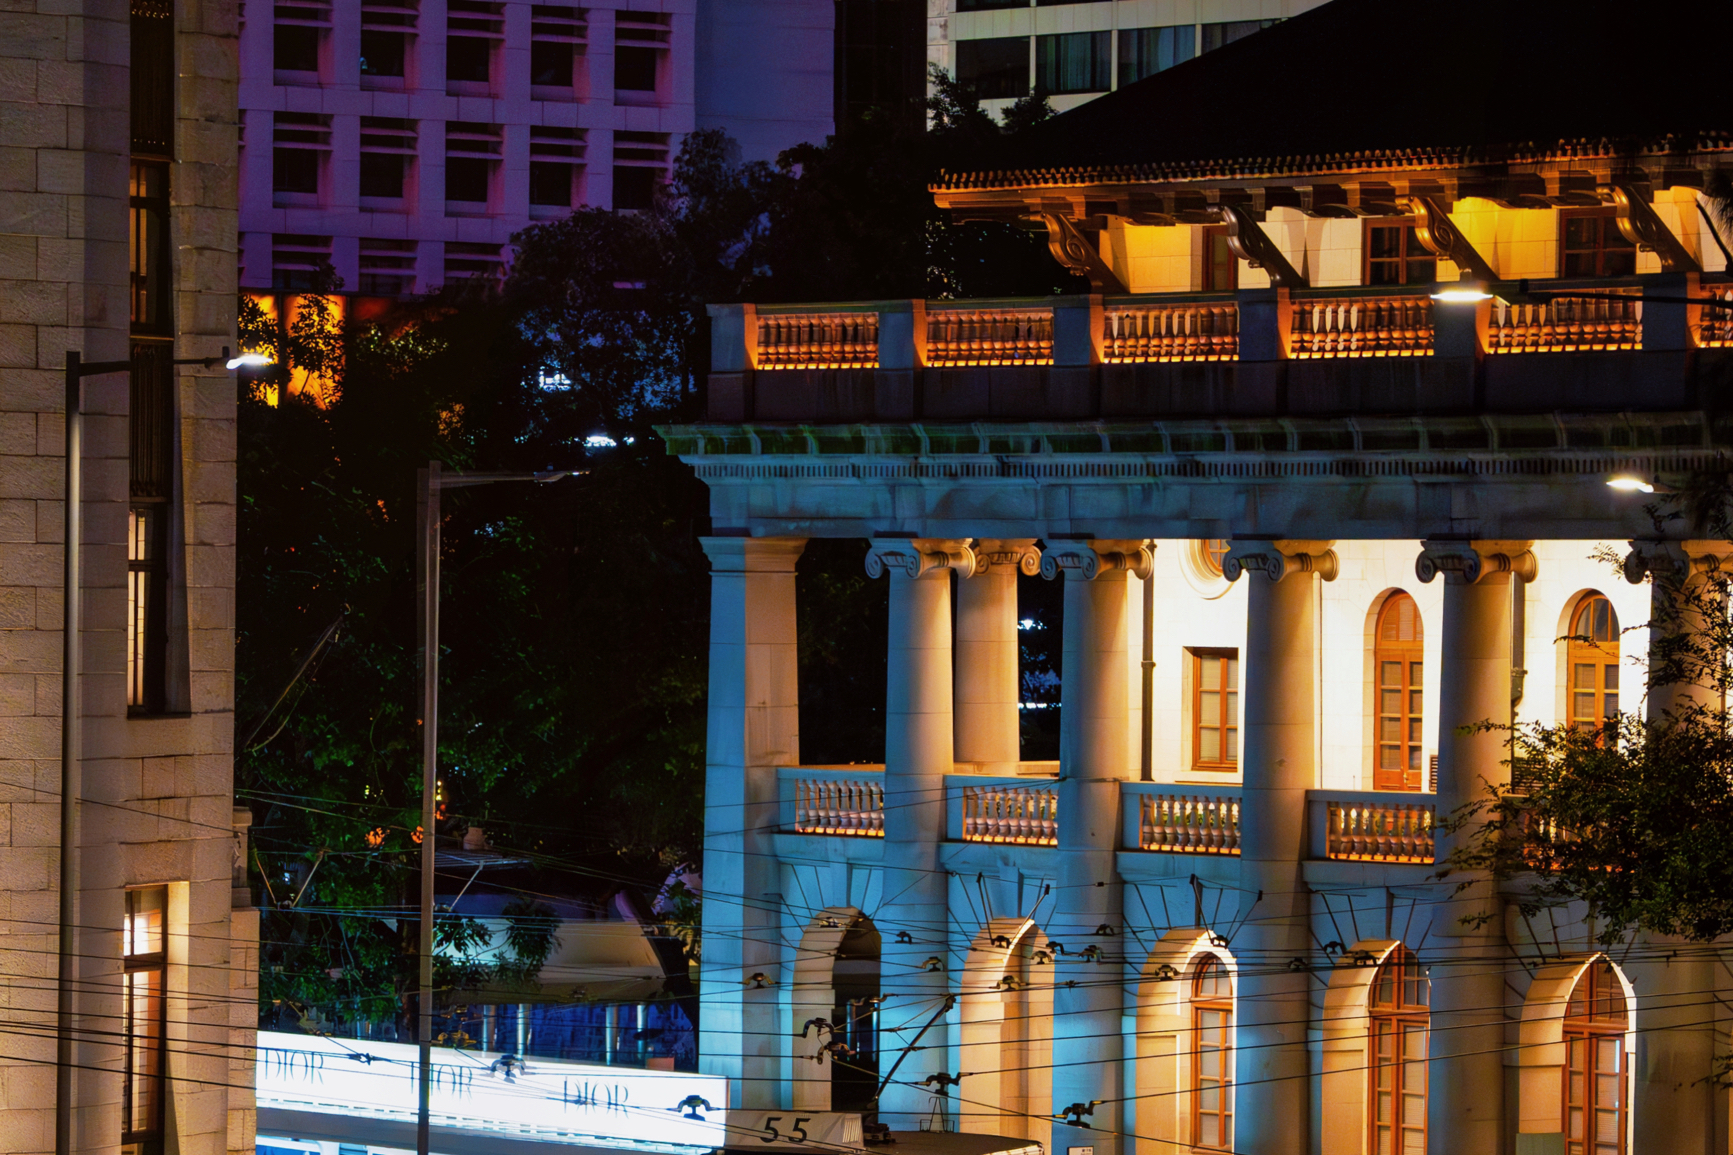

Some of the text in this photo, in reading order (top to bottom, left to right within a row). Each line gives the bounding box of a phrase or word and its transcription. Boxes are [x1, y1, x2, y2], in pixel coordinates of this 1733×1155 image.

[264, 1048, 324, 1085] DIOR
[564, 1076, 630, 1118] DIOR
[760, 1117, 811, 1143] 55
